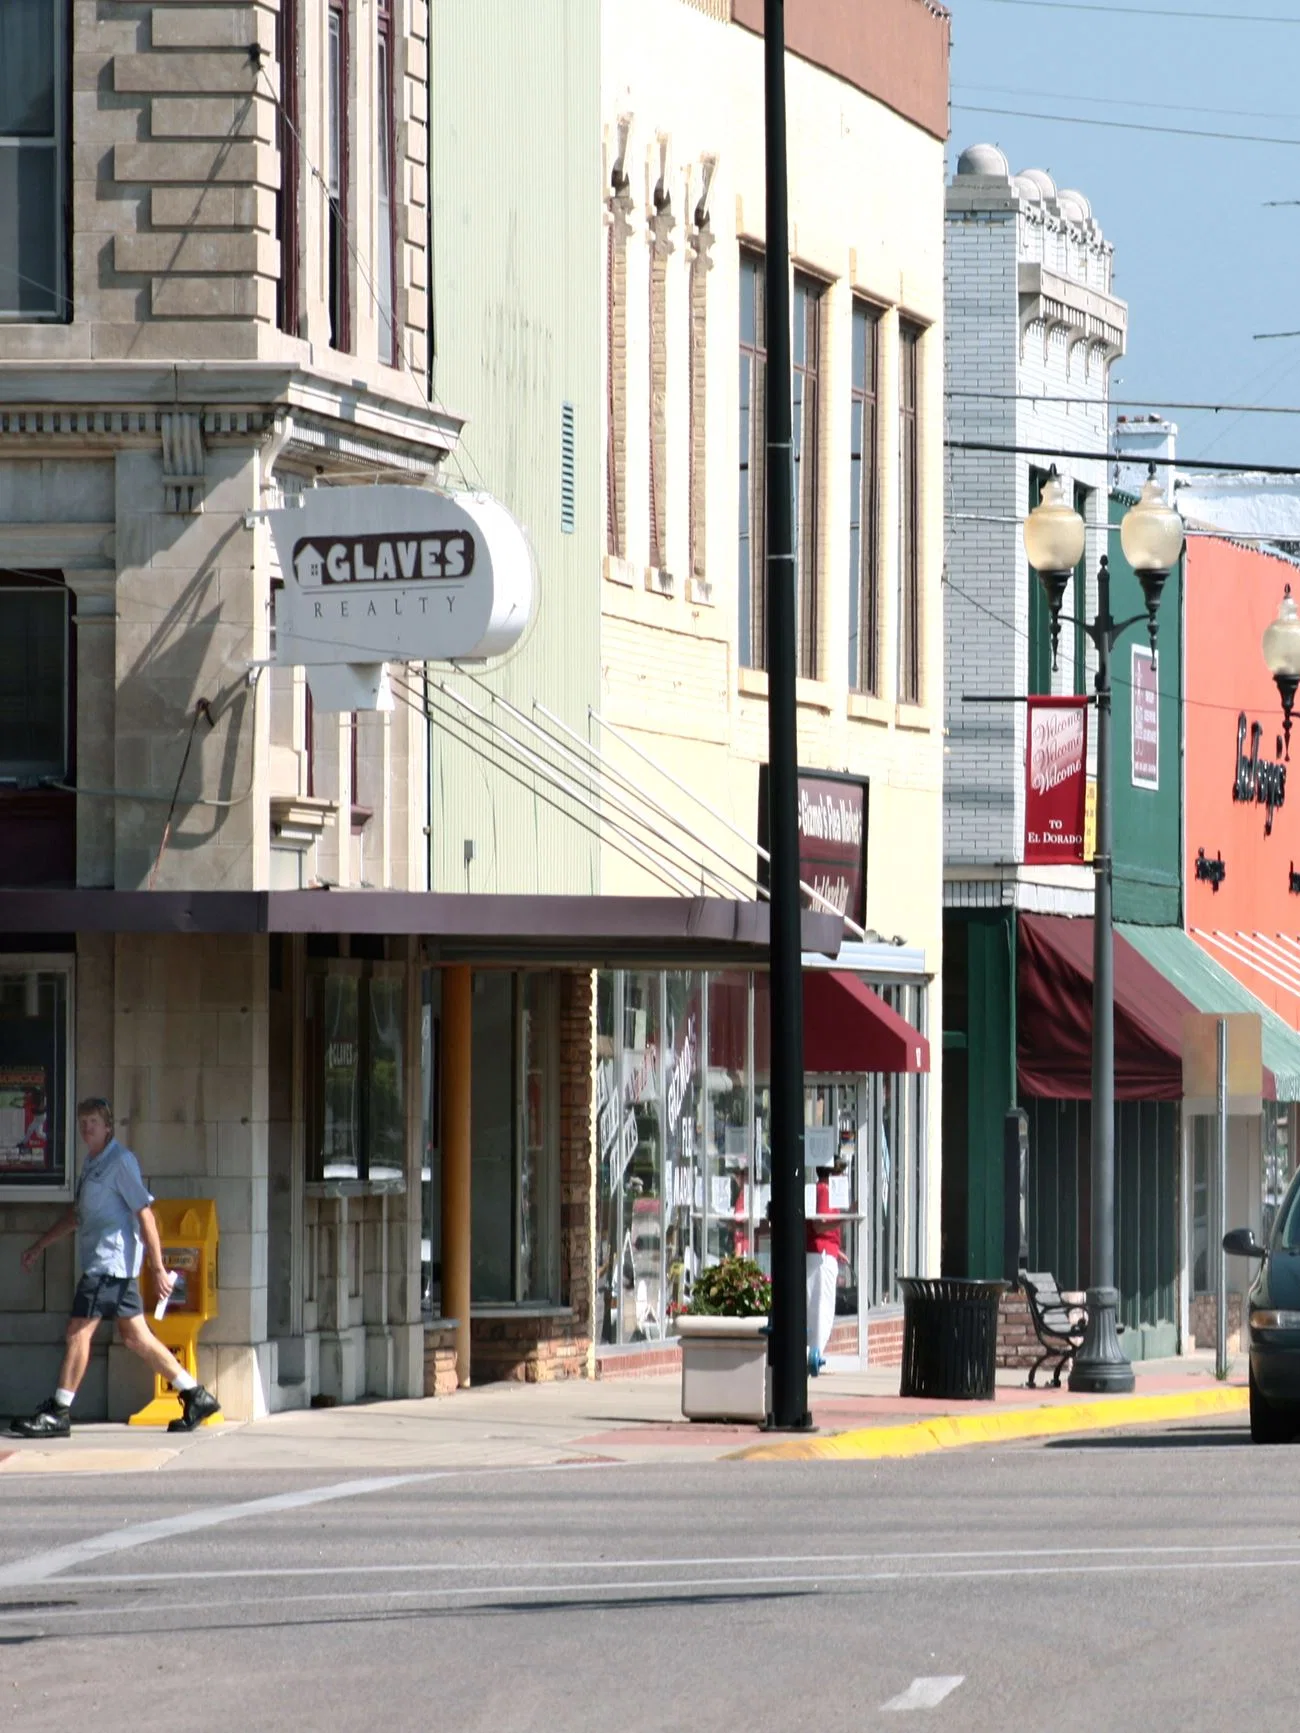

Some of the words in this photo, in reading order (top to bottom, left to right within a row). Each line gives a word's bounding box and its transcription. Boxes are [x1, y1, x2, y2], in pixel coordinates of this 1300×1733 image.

[327, 538, 465, 582] GLAVES
[314, 596, 456, 617] REALTY
[1032, 759, 1082, 796] Welcome
[1049, 820, 1062, 829] TO
[1028, 832, 1041, 843] EL
[1043, 831, 1082, 844] DORADO
